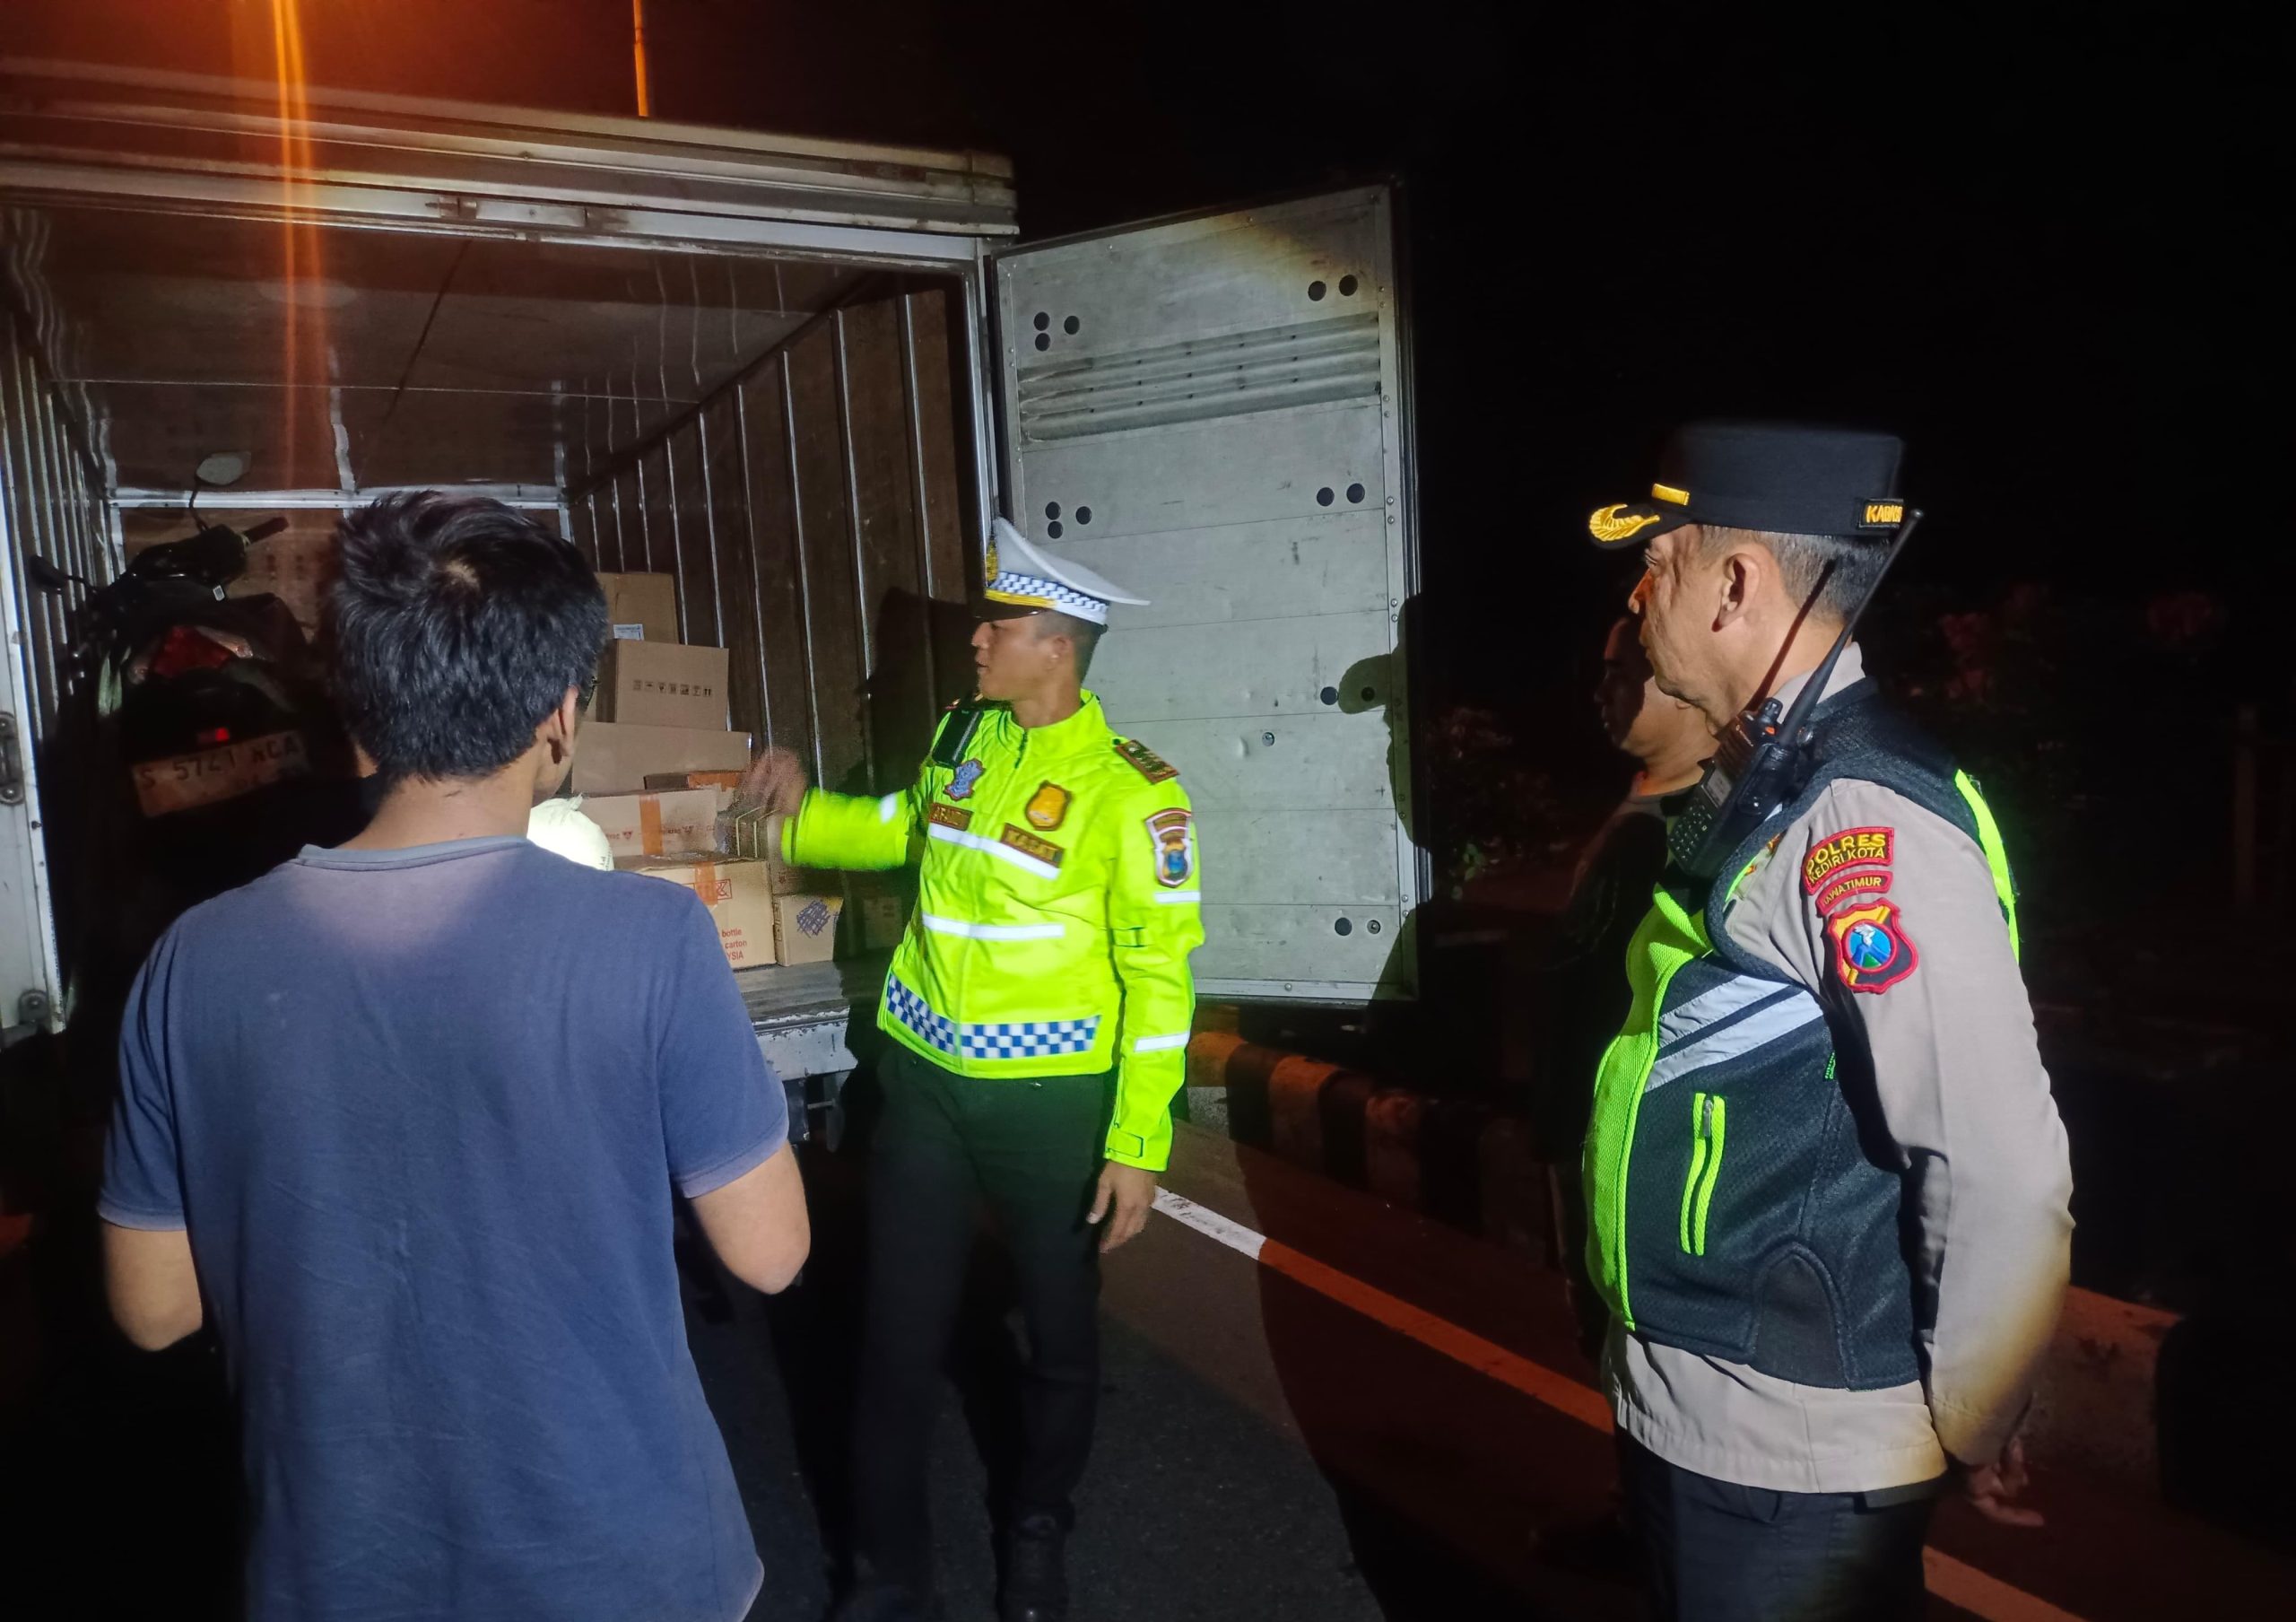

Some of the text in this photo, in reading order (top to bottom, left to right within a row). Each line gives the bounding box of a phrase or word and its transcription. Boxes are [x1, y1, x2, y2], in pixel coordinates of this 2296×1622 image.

[1805, 833, 1886, 876] POLRES
[1809, 847, 1885, 884] KEDIRI KOTA
[1844, 876, 1882, 891] TIMUR
[721, 928, 743, 937] bottle
[725, 940, 747, 949] carton
[726, 951, 744, 961] YSIA
